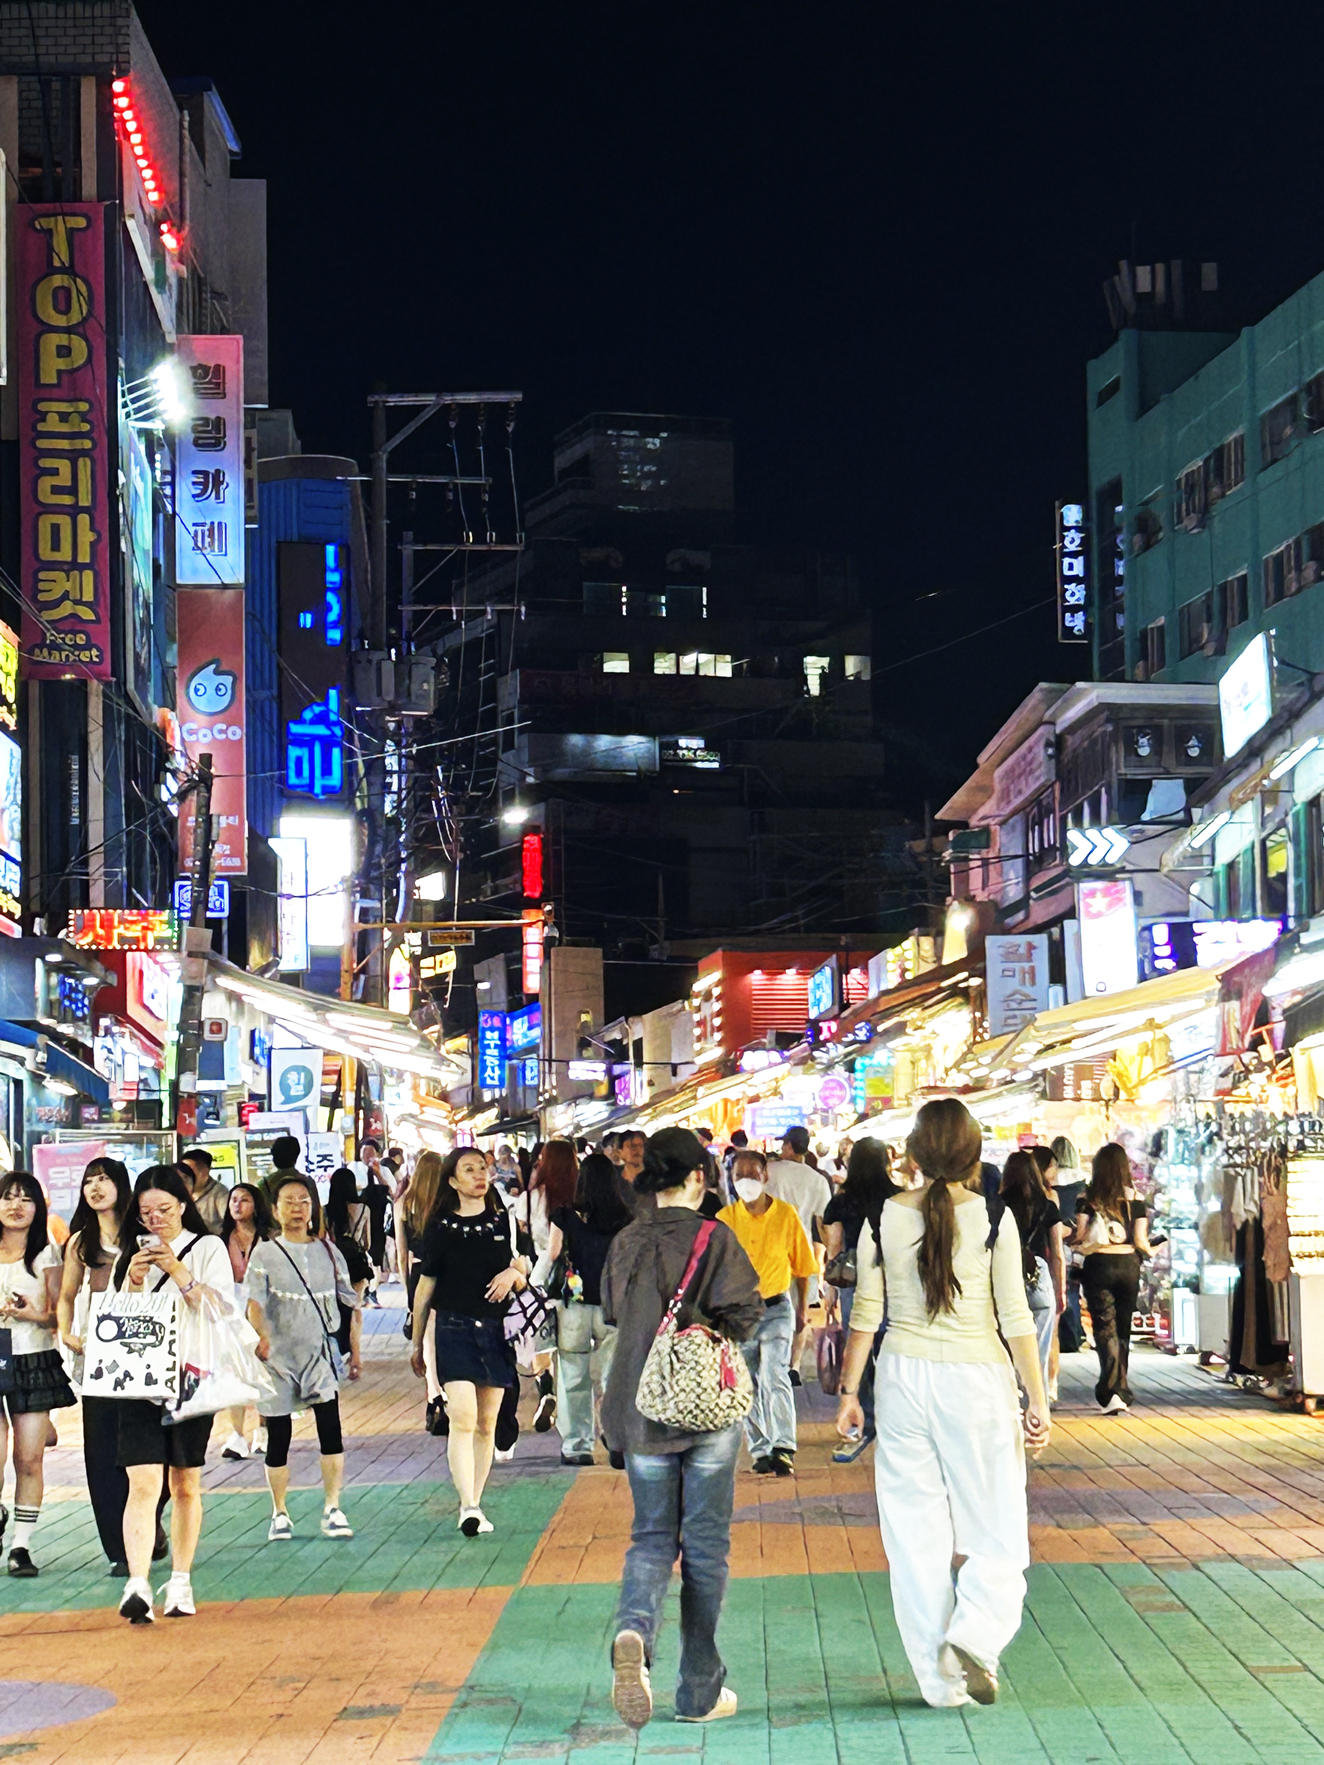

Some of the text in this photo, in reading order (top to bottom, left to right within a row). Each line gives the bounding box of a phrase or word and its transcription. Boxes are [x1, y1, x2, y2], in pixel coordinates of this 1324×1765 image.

[46, 632, 87, 645] Free
[181, 722, 243, 744] CoCo
[75, 908, 172, 949] 사주
[483, 1020, 501, 1085] 부동산
